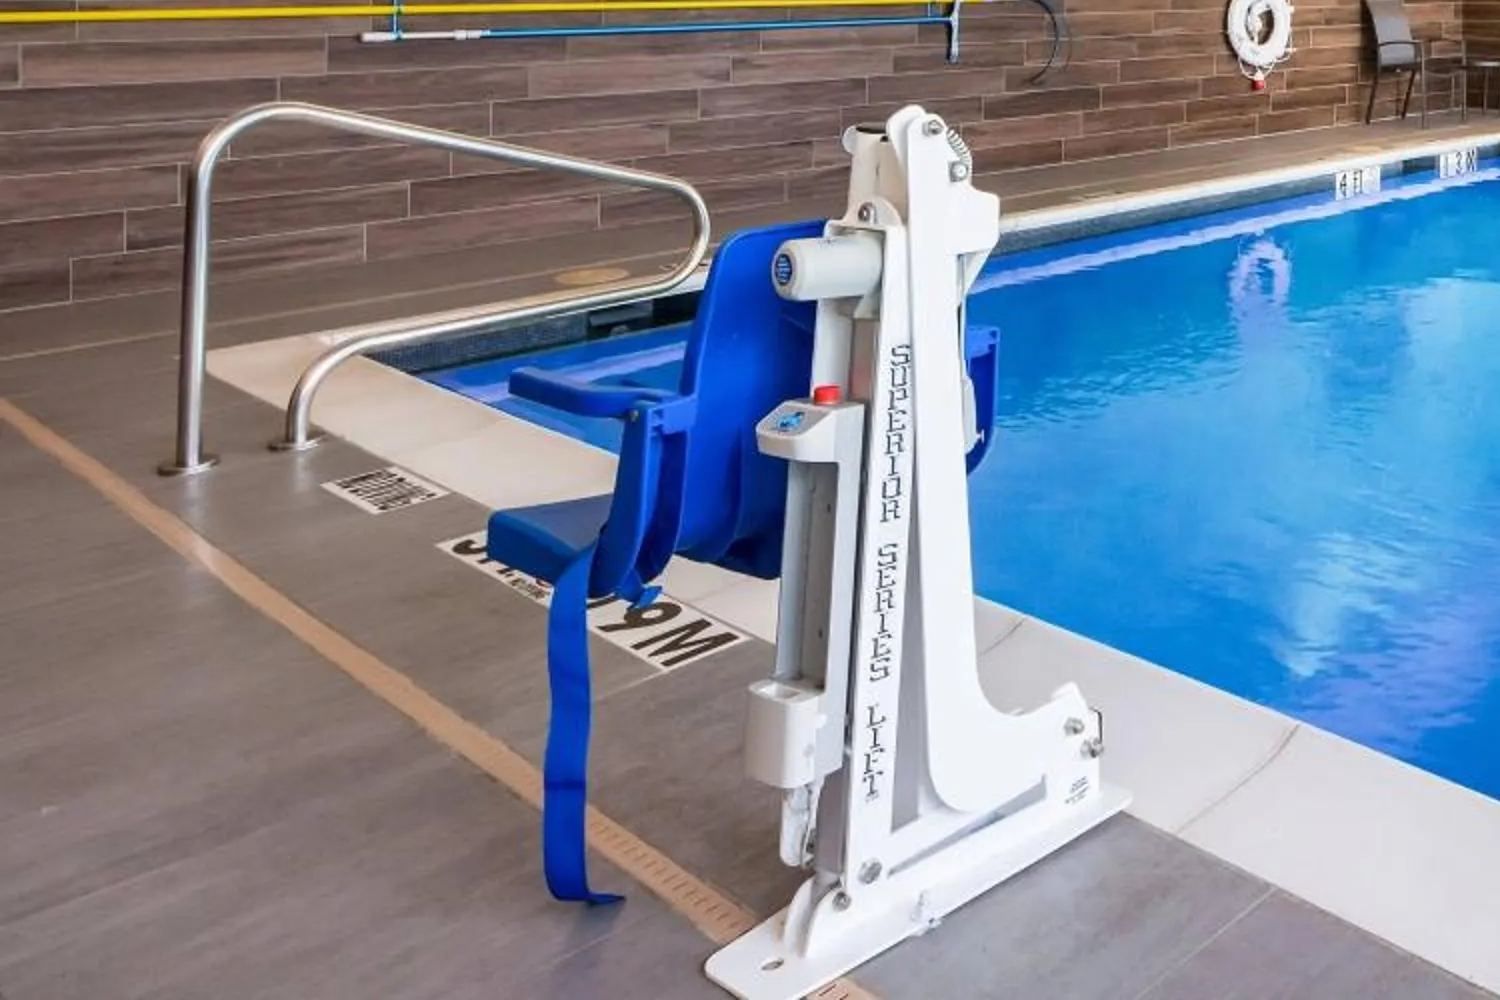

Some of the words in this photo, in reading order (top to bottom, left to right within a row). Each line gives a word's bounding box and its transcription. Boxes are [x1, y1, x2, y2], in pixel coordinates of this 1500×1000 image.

[879, 344, 911, 523] SUPERIOR
[869, 542, 898, 683] SERIES
[862, 702, 886, 802] LIFT
